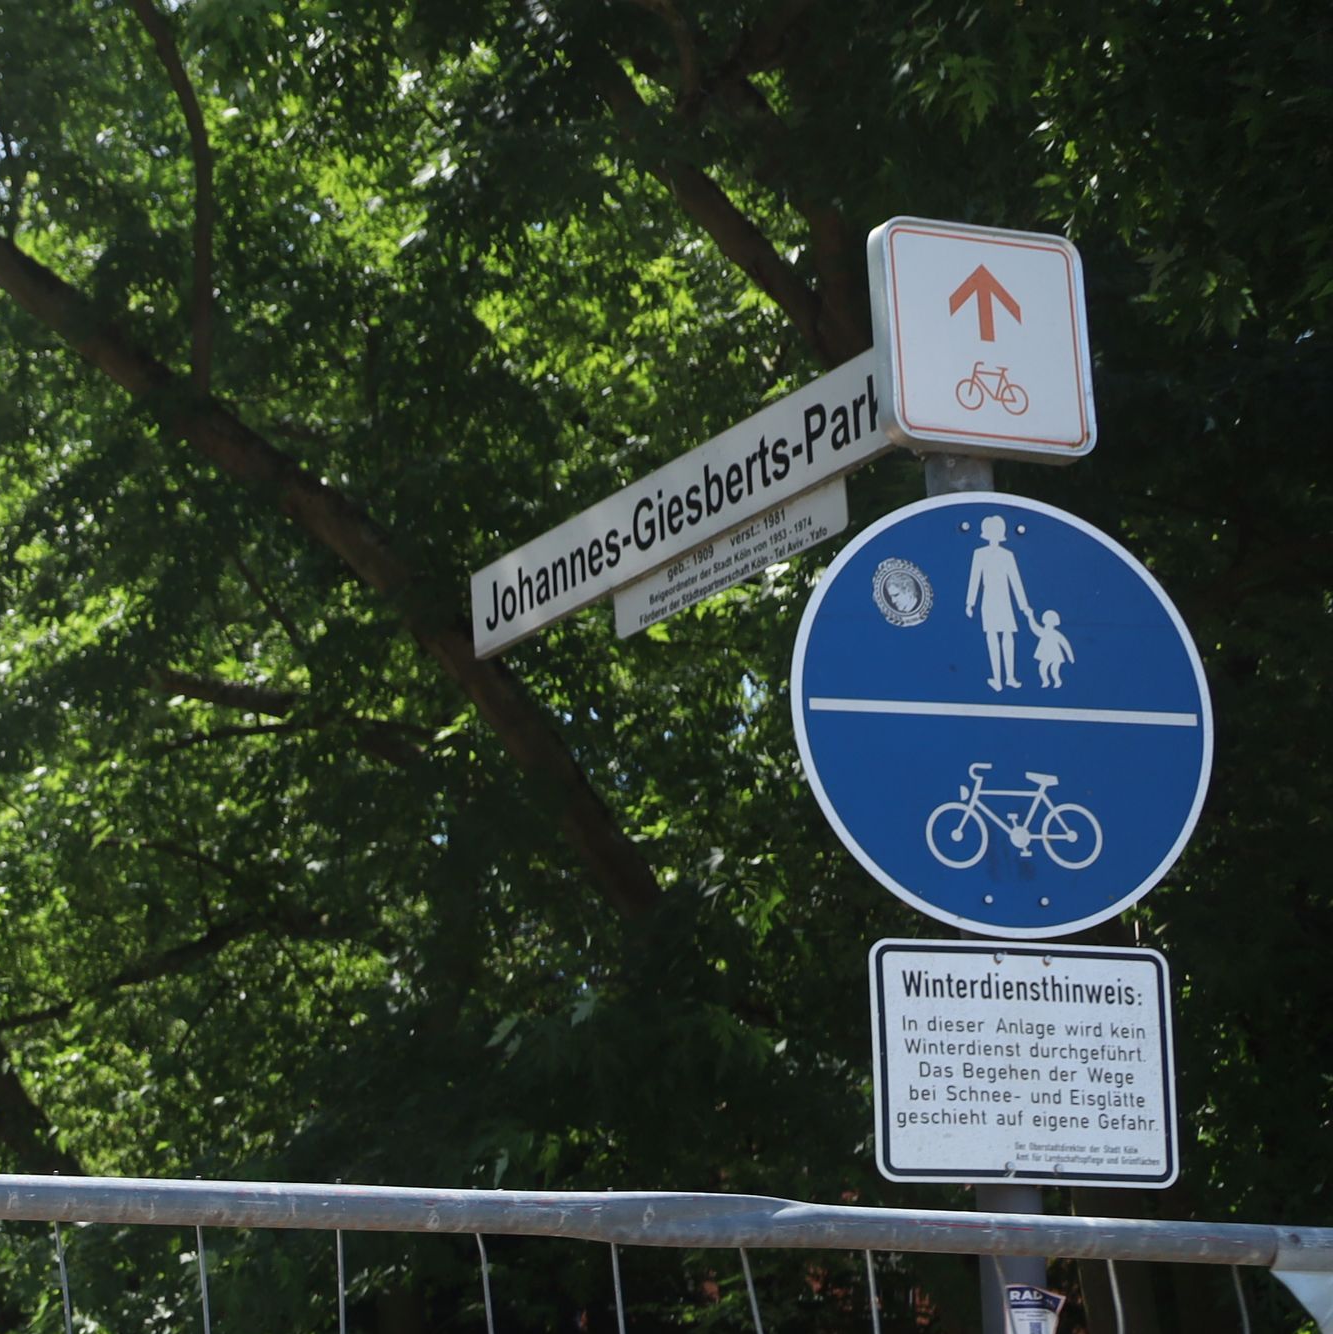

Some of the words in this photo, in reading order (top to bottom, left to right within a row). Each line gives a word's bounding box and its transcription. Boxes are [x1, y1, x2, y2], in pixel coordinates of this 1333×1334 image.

[667, 559, 691, 581] geb.:
[692, 545, 714, 566] 1909
[730, 526, 761, 547] verst.:
[763, 509, 786, 531] 1981
[649, 573, 697, 603] Beigeordneter
[700, 565, 711, 579] der
[713, 555, 732, 573] Stadt
[734, 546, 750, 563] Köln
[753, 539, 767, 553] von
[769, 528, 786, 545] 1953
[794, 515, 813, 533] 1974
[639, 602, 667, 626] Förderer
[670, 597, 679, 611] der
[682, 565, 749, 603] Städtepartnerschaft
[751, 553, 768, 571] Köln
[774, 545, 785, 560] Tel
[788, 536, 803, 553] Aviv
[810, 524, 828, 543] Yafo
[902, 970, 1142, 1006] Winterdiensthinweis:
[902, 1016, 918, 1031] In
[927, 1016, 985, 1034] dieser
[996, 1018, 1055, 1039] Anlage
[1065, 1022, 1102, 1038] wird
[1111, 1024, 1146, 1039] kein
[905, 1039, 1021, 1058] Winterdienst
[1029, 1042, 1146, 1064] durchgeführt.
[919, 1062, 953, 1079] Das
[963, 1064, 1041, 1083] Begehen
[1049, 1067, 1077, 1082] der
[1087, 1068, 1134, 1088] Wege
[909, 1085, 936, 1101] bei
[946, 1086, 1021, 1103] Schnee-
[1031, 1088, 1061, 1105] und
[1071, 1089, 1145, 1109] Eisglätte
[897, 1109, 987, 1127] geschieht
[996, 1111, 1023, 1127] auf
[1032, 1112, 1089, 1132] eigene
[1099, 1114, 1159, 1132] Gefahr.
